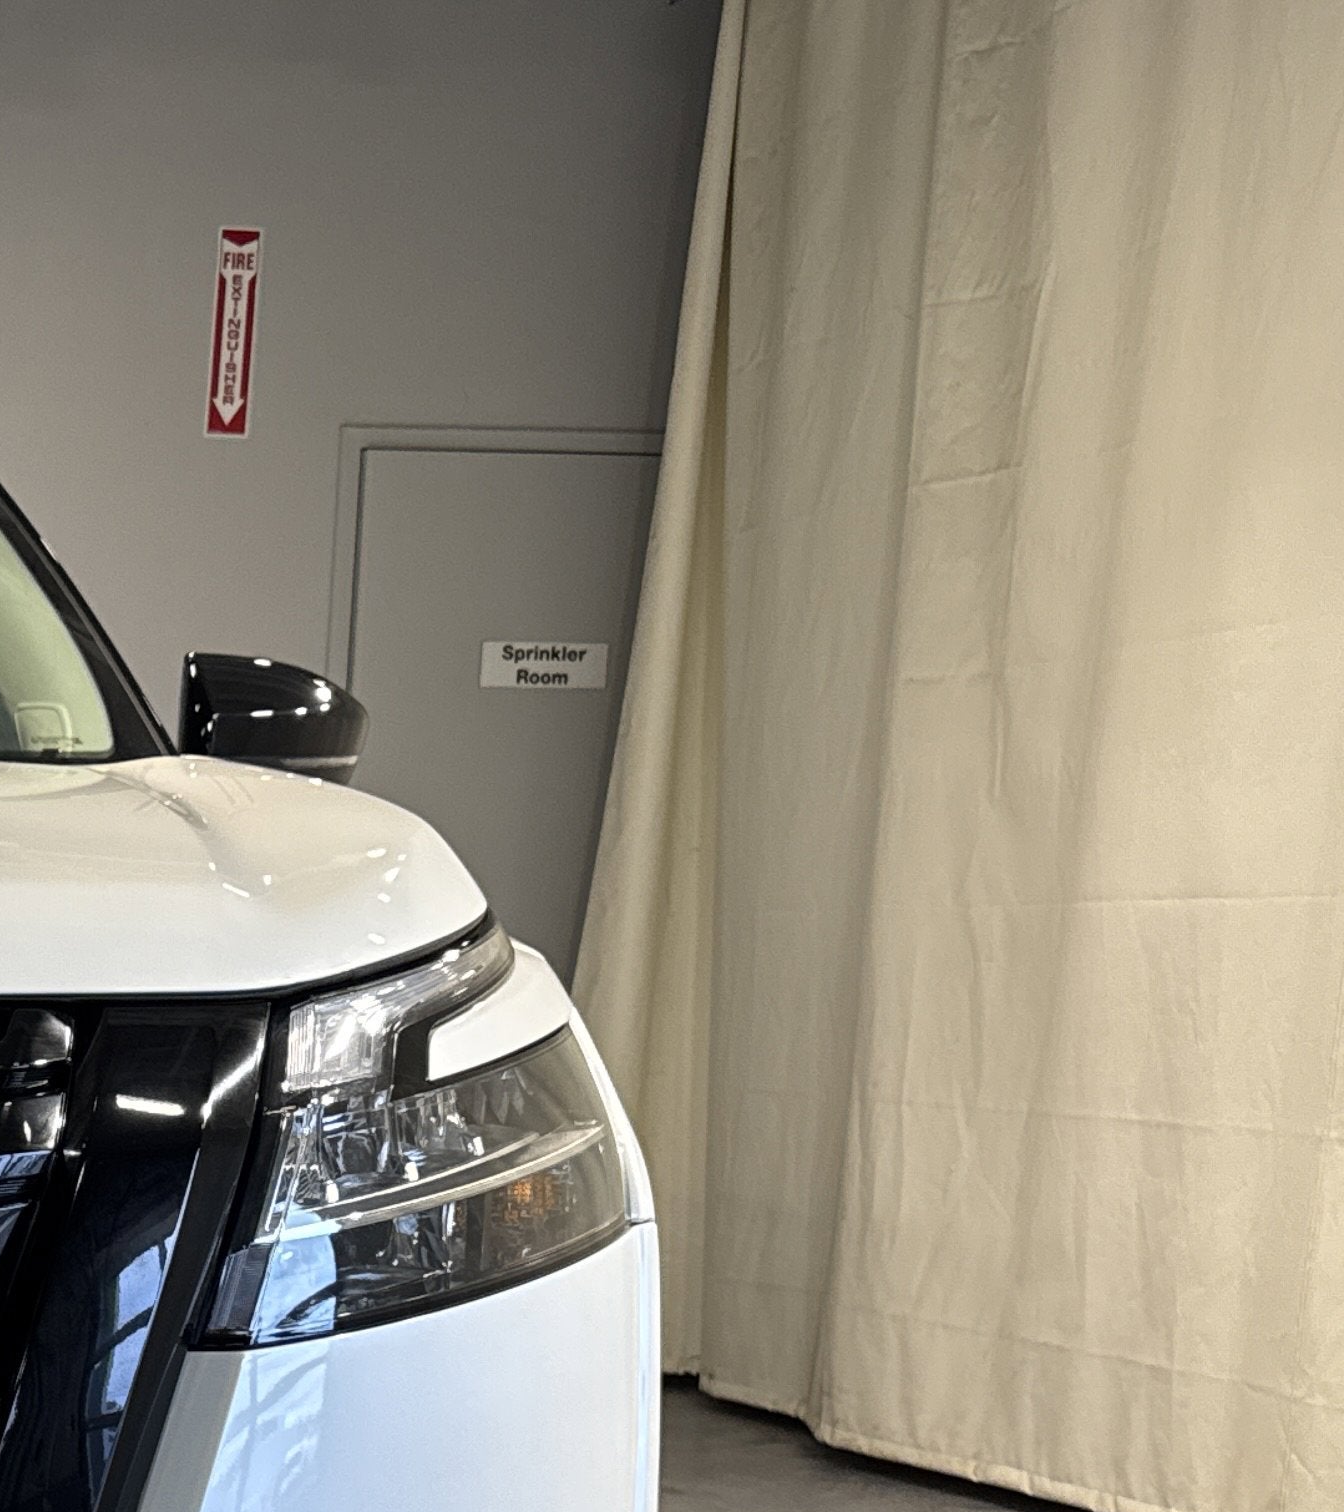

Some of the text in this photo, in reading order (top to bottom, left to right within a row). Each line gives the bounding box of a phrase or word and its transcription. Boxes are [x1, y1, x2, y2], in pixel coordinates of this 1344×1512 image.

[223, 252, 255, 270] FIRE
[502, 645, 588, 663] Sprinkler
[516, 669, 569, 685] Room
